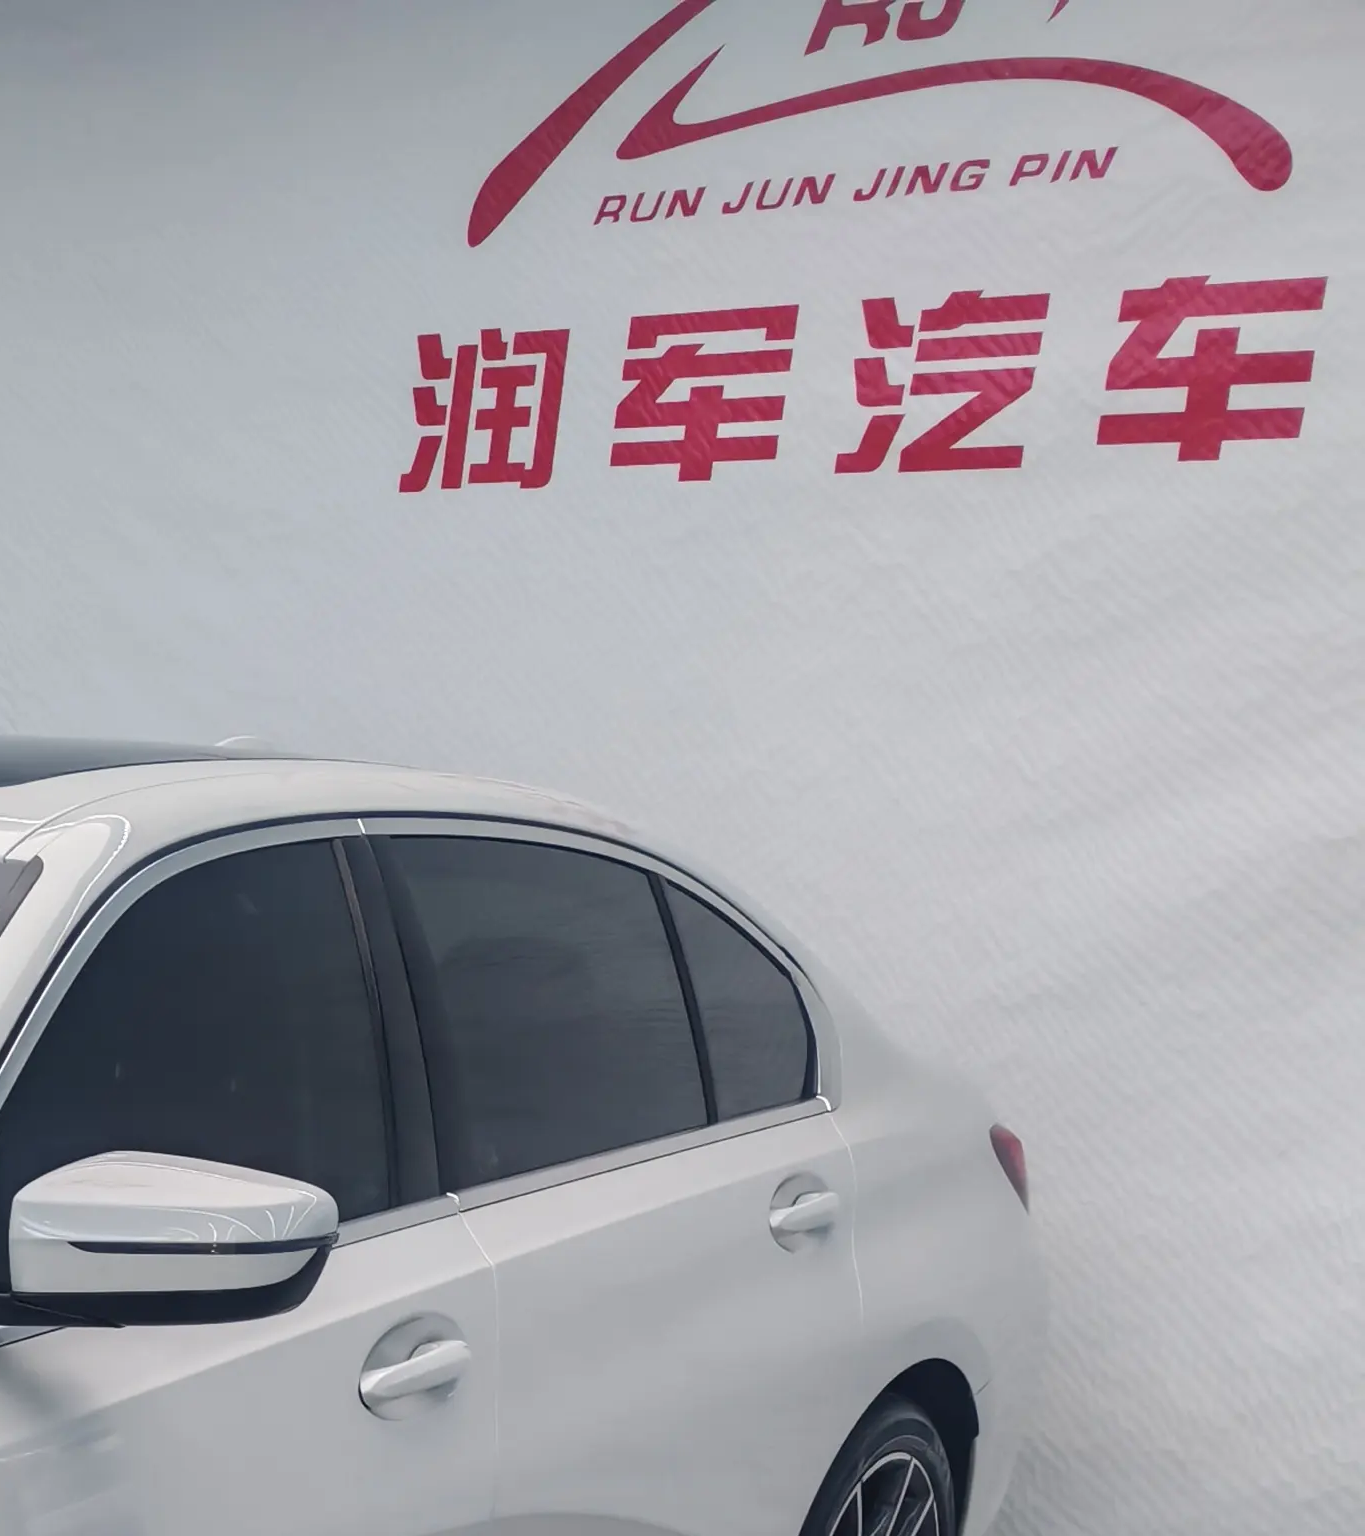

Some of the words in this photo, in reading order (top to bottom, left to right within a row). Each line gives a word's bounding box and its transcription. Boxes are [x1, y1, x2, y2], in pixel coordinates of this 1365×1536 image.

[592, 186, 707, 226] RUN
[721, 172, 836, 215] JUN
[853, 157, 991, 203] JING
[1008, 145, 1119, 188] PIN
[398, 274, 1329, 493] 润军汽车
